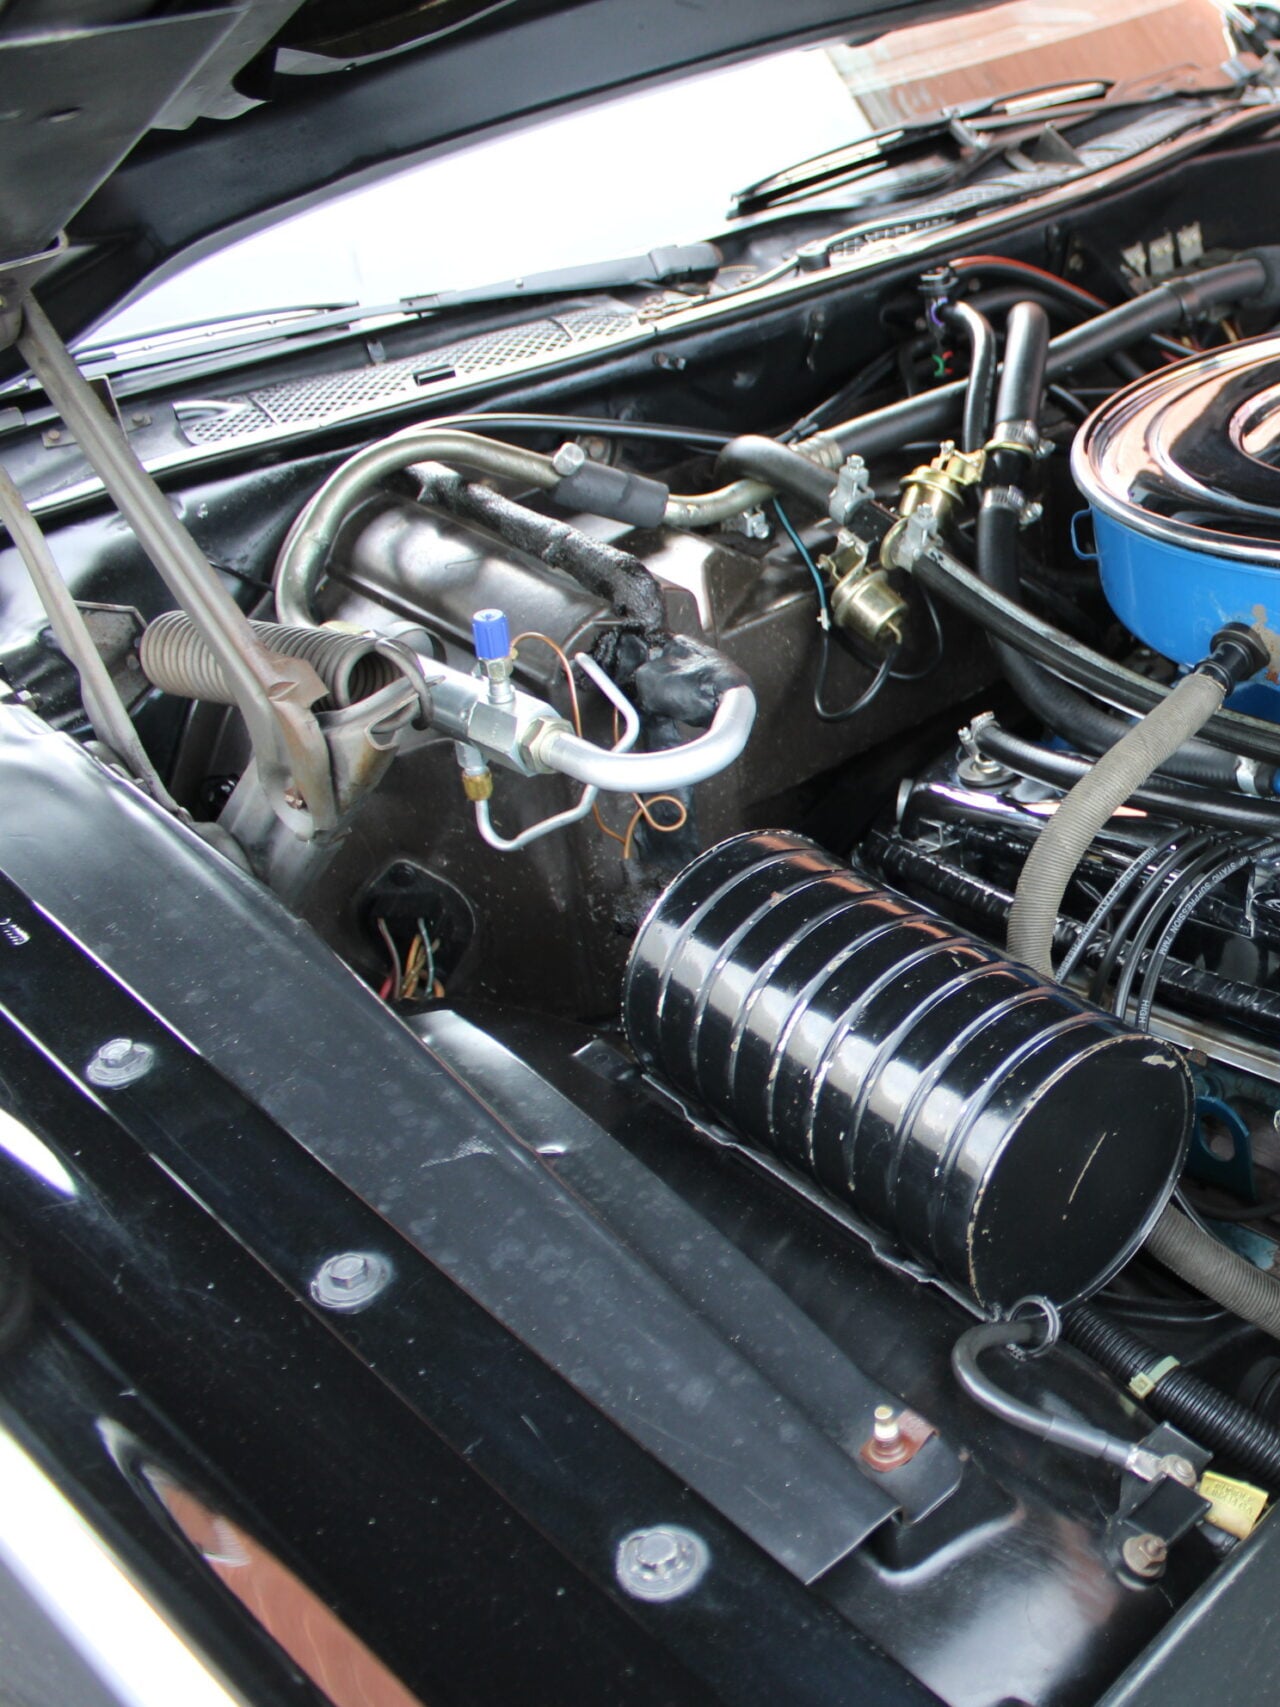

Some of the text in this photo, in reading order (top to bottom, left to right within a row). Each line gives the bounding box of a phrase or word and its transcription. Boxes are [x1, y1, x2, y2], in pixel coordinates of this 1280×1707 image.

[1137, 846, 1159, 865] HIGH
[1117, 866, 1138, 889] TEMP
[1210, 861, 1238, 883] STATIC
[1169, 881, 1212, 933] SUPPRESSION
[1157, 934, 1172, 957] 7MM
[1138, 1000, 1150, 1024] HIGH
